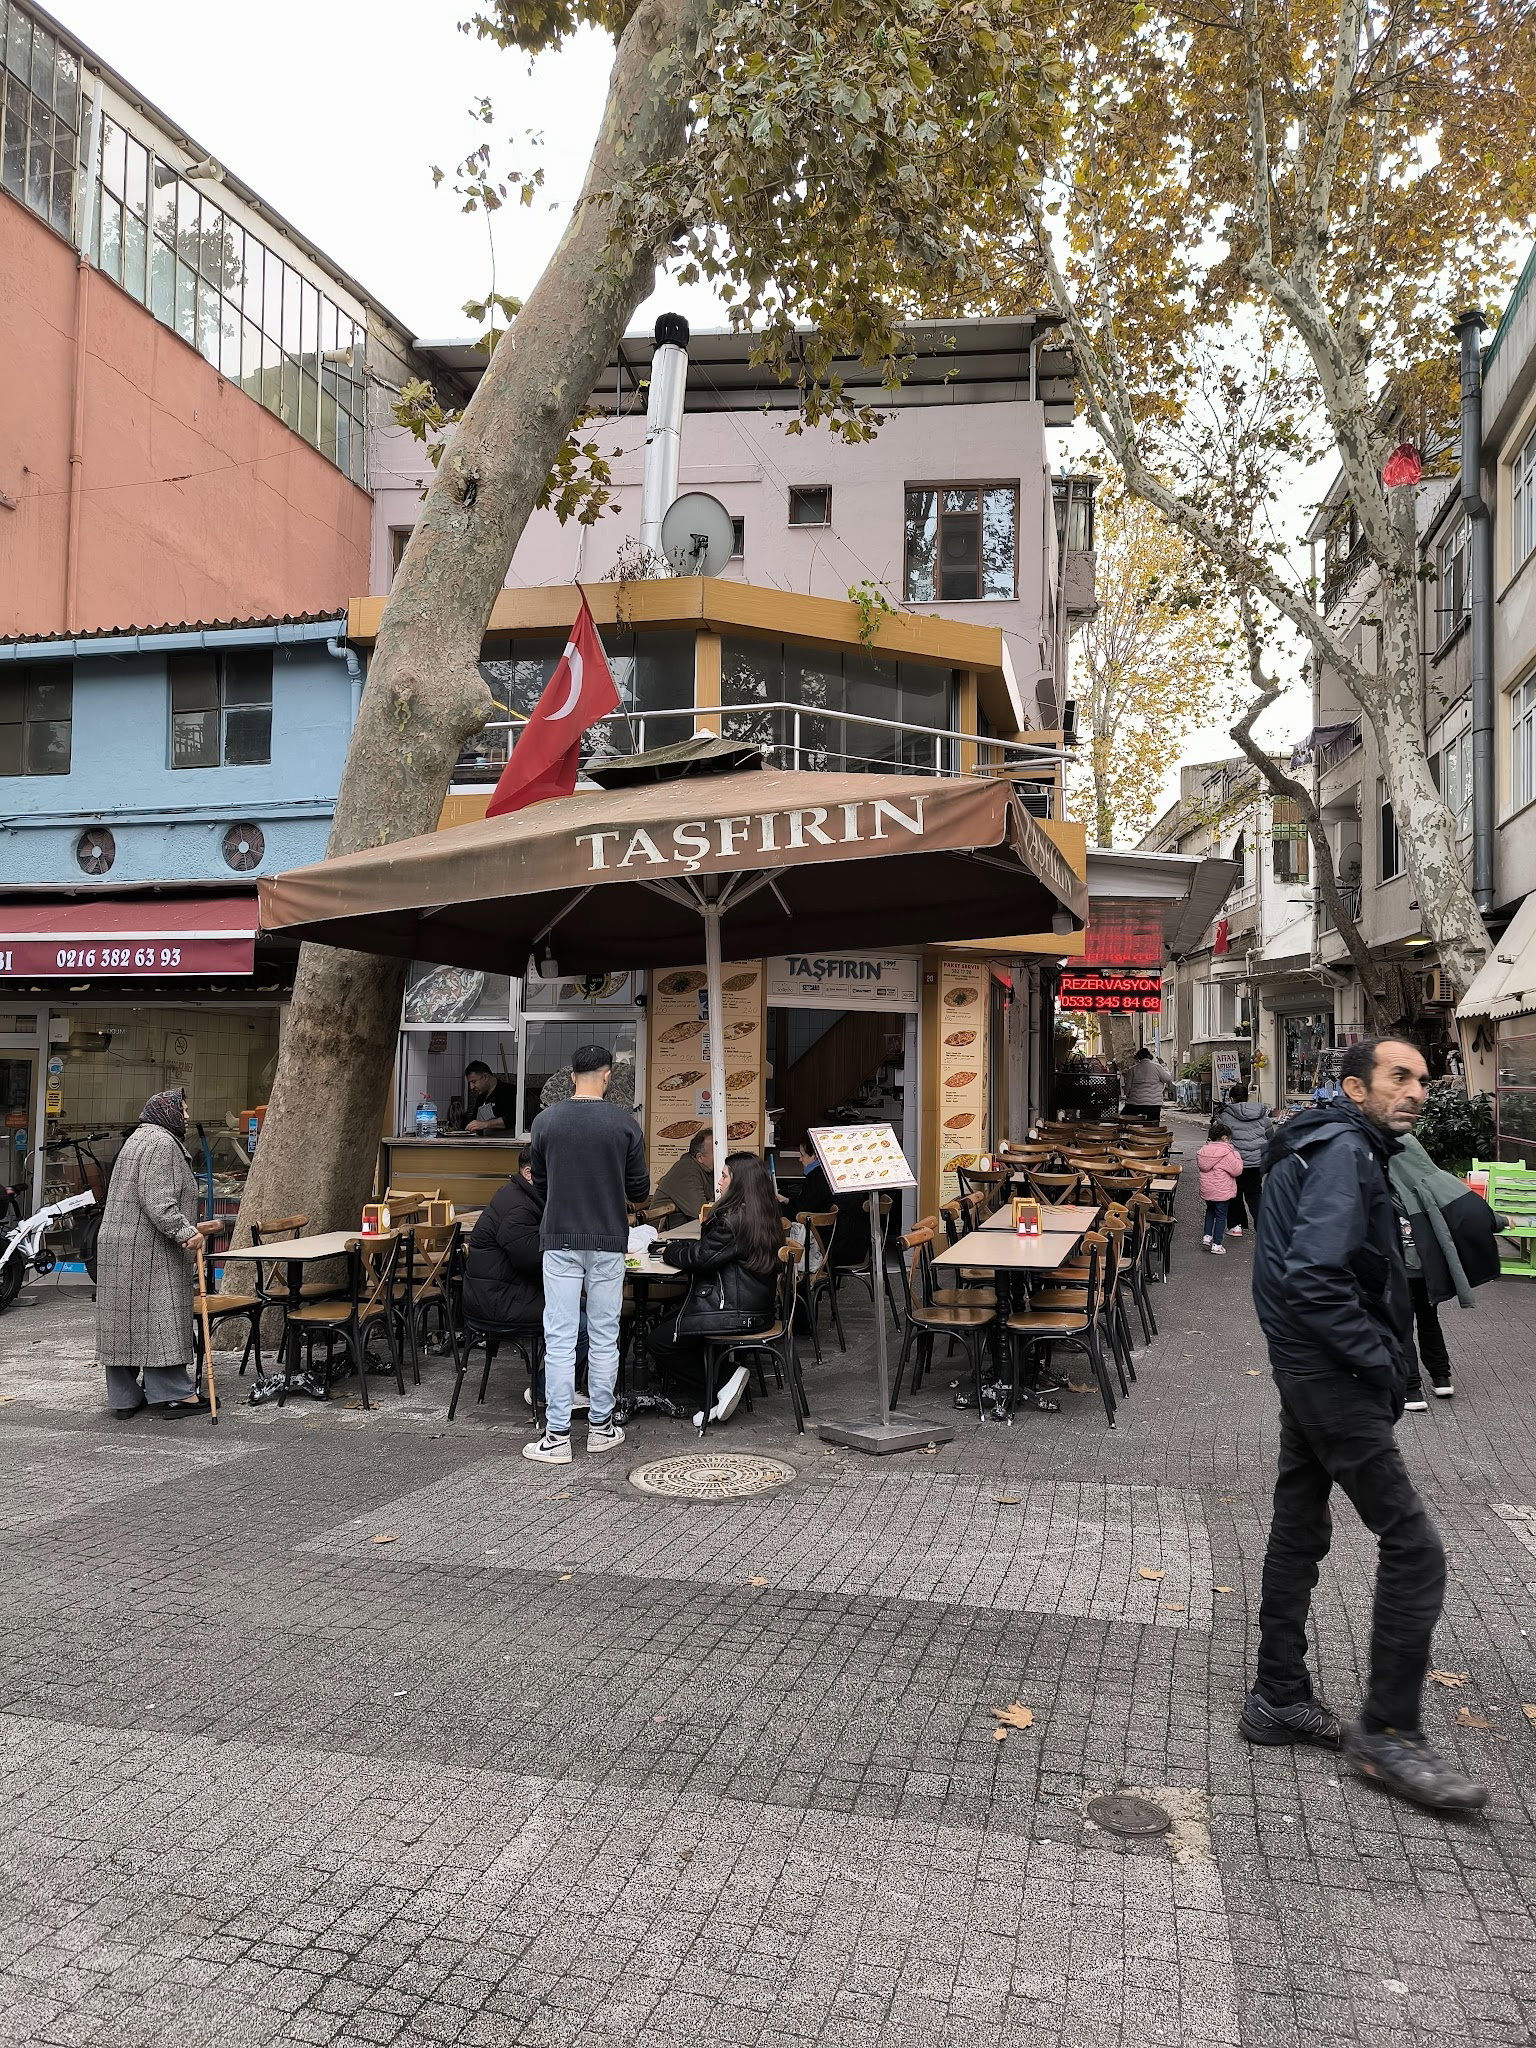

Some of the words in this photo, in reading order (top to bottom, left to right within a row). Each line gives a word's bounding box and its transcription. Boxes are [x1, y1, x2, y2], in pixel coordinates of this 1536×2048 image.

[575, 794, 930, 871] TAŞFIRIN
[56, 949, 96, 968] 0216
[100, 948, 130, 967] 382
[134, 948, 155, 967] 63
[160, 948, 181, 967] 93
[784, 957, 882, 981] TAŞFIRIN
[1062, 978, 1160, 991] REZERVASYON
[1062, 996, 1093, 1007] 0533
[1095, 996, 1120, 1008] 345
[1122, 997, 1140, 1008] 84
[1142, 997, 1160, 1008] 68
